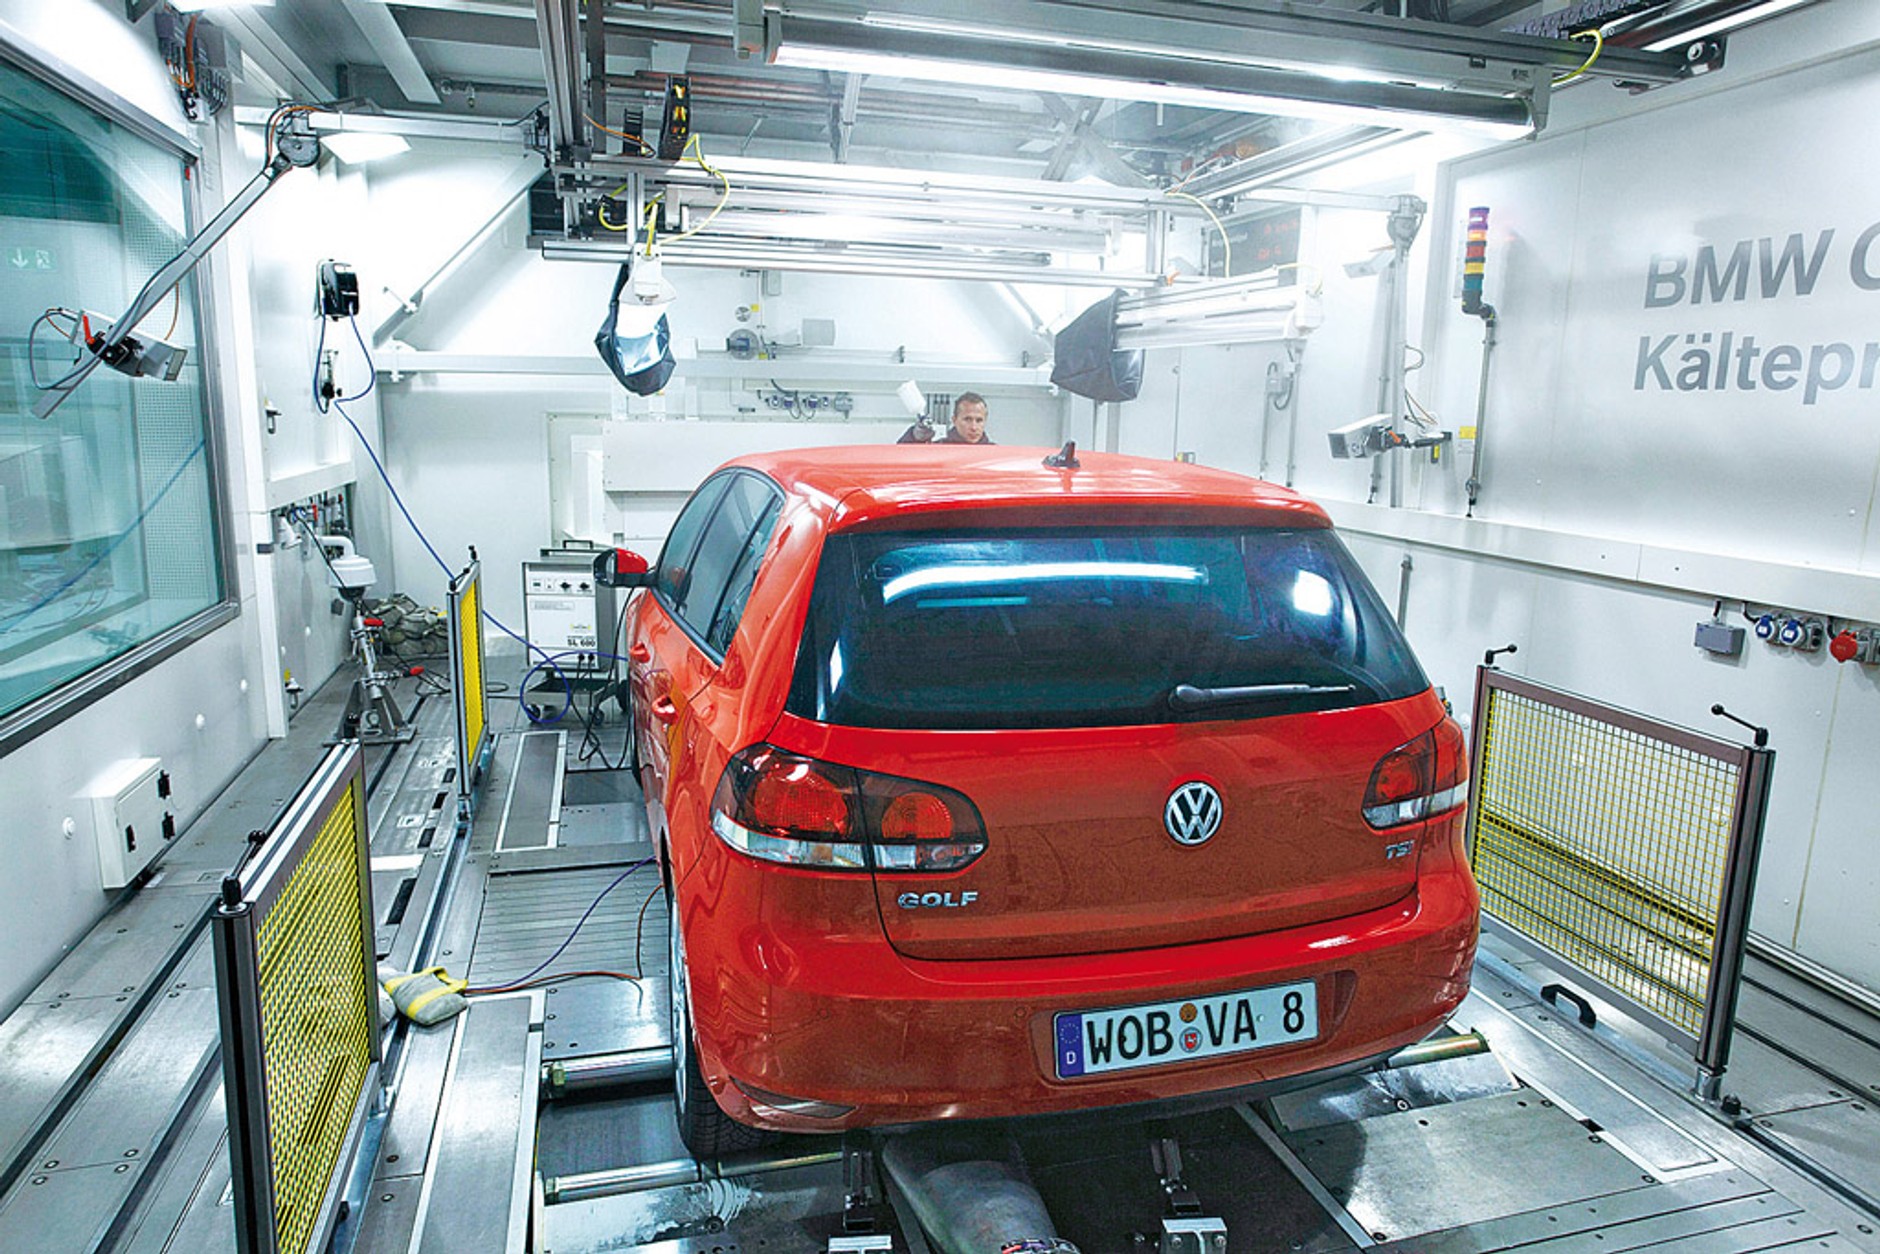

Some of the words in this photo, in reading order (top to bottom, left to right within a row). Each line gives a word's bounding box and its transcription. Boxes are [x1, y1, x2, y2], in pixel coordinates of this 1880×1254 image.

[1644, 228, 1835, 309] BMW
[1385, 839, 1415, 859] TSI
[898, 891, 978, 908] GOLF
[1086, 1010, 1174, 1065] WOB
[1203, 999, 1256, 1046] VA
[1282, 991, 1304, 1034] 8
[1066, 1051, 1076, 1065] D
